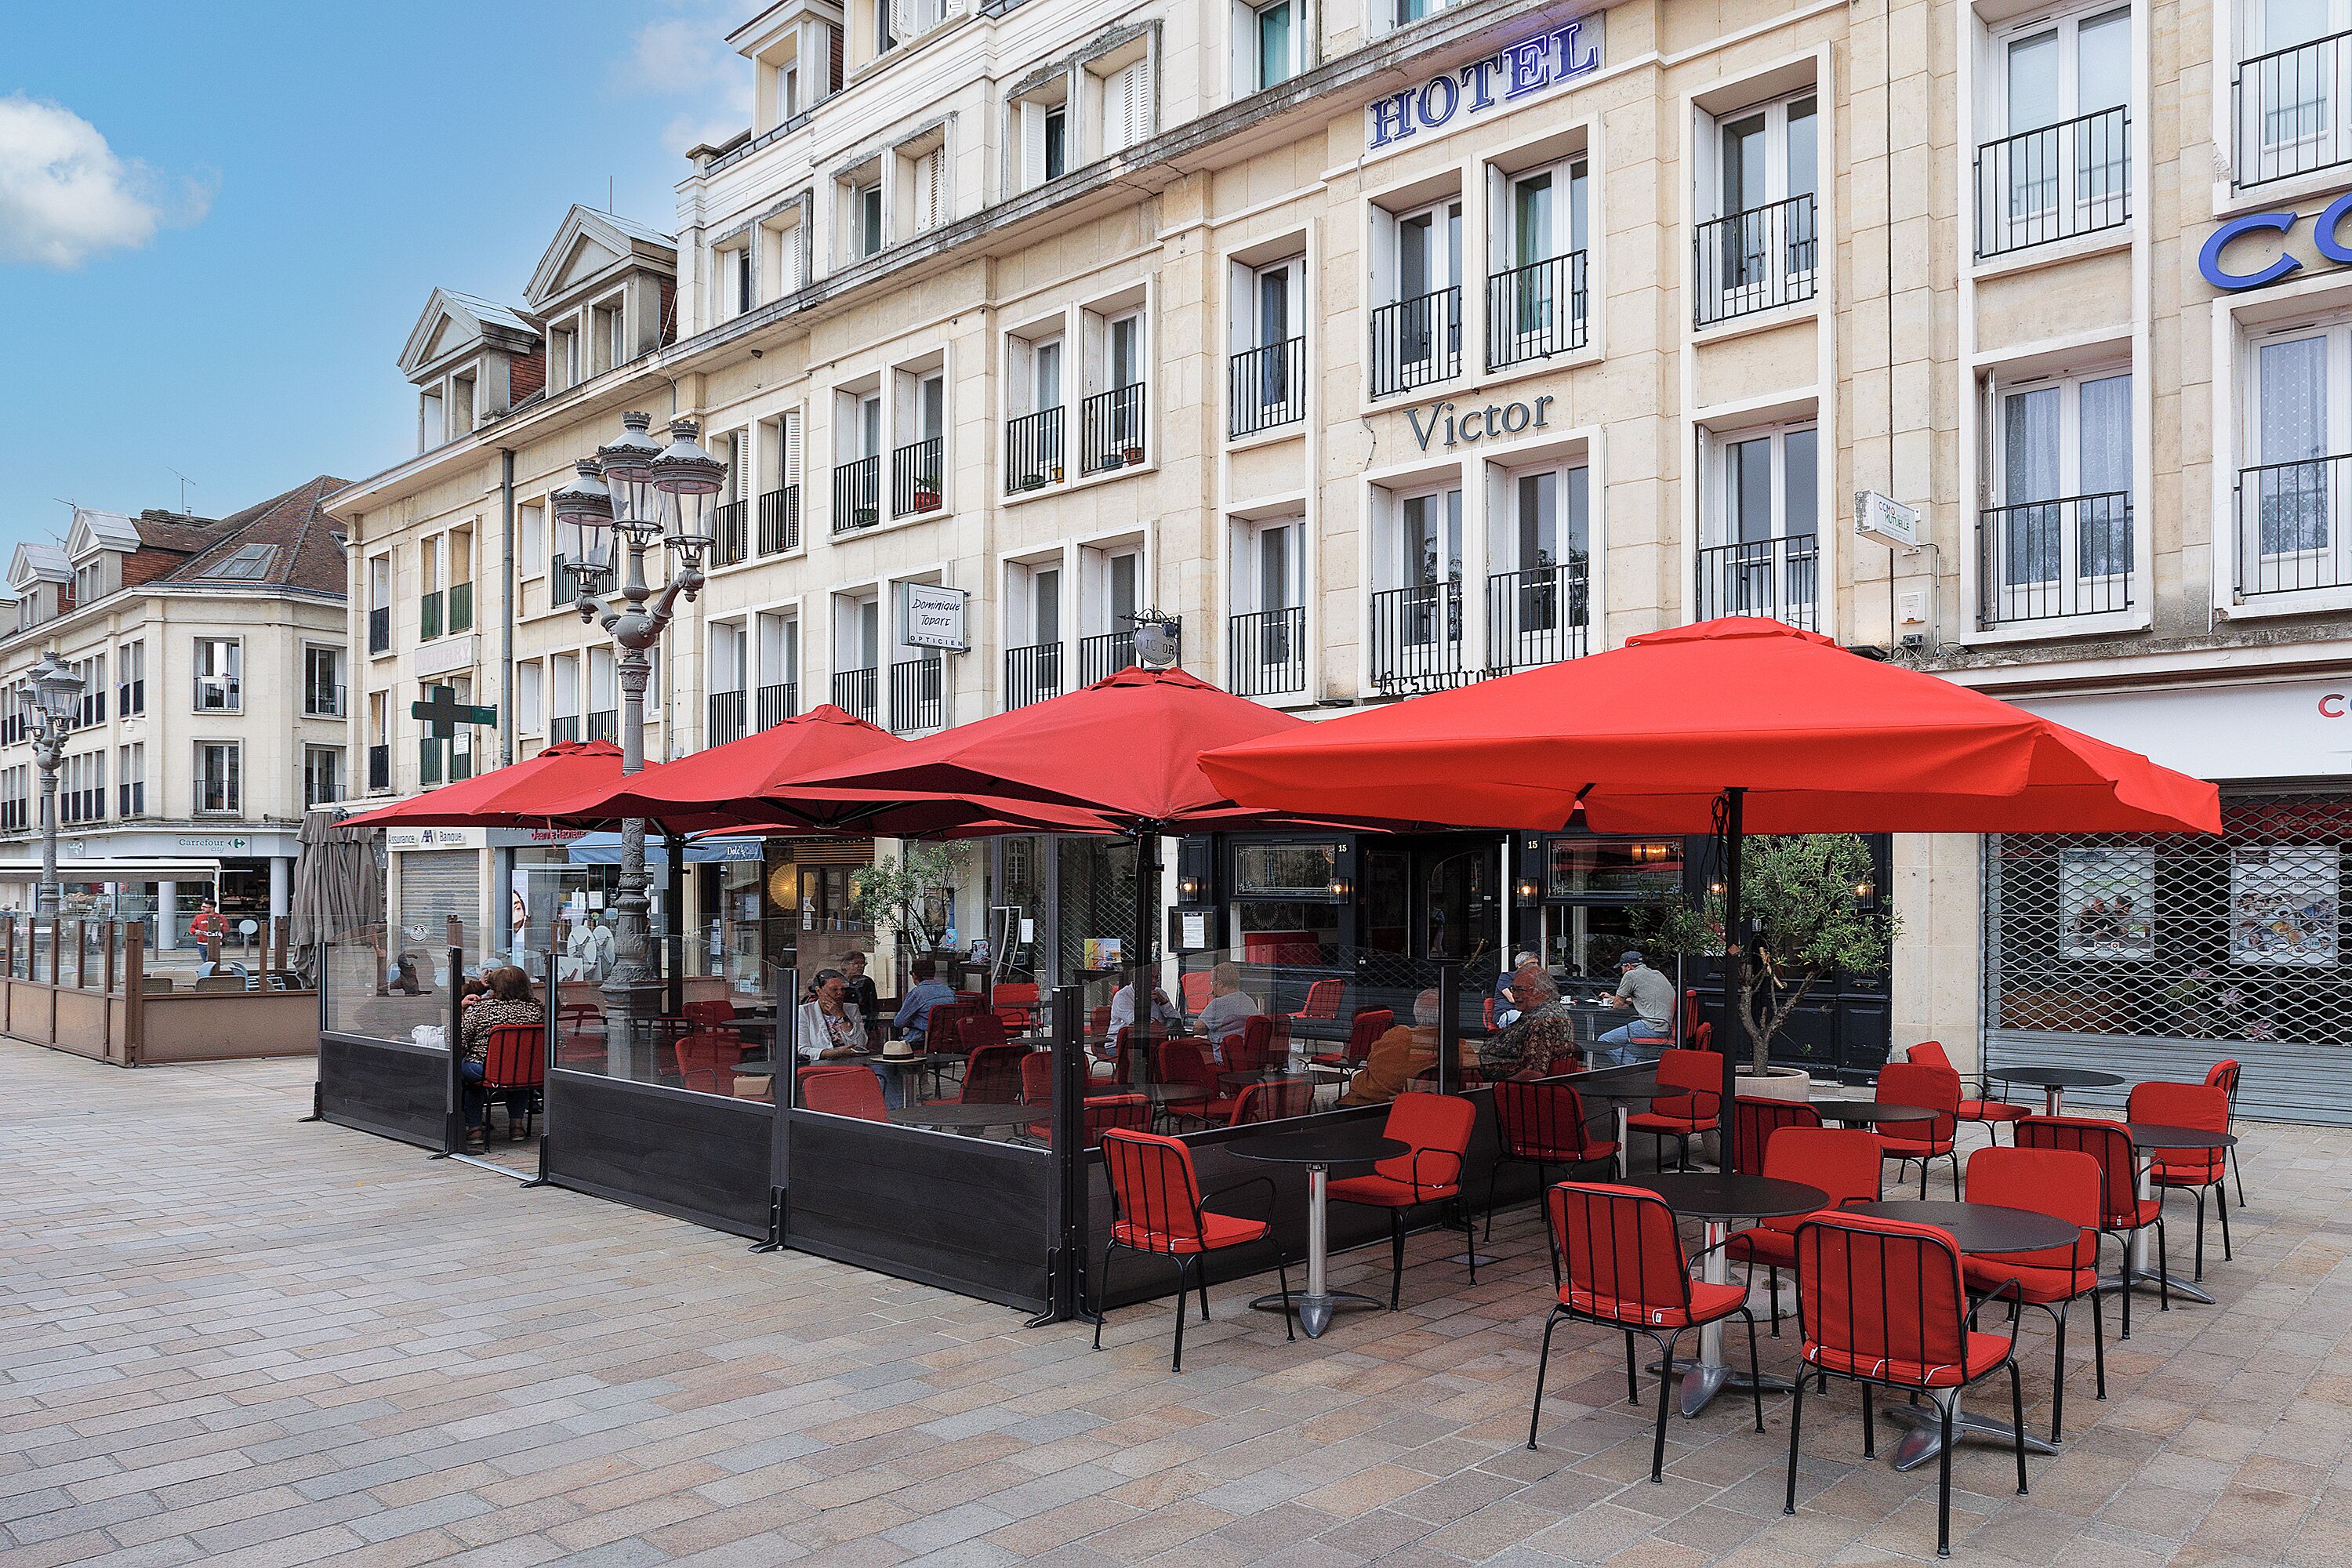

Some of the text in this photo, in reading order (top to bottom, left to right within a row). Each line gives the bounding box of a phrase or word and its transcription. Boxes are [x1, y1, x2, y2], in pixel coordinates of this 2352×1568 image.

[1368, 23, 1599, 150] HOTEL
[1403, 394, 1554, 452] Victor
[1878, 501, 1896, 516] CCMO
[911, 598, 961, 612] Dominique
[909, 635, 963, 647] OPTICIEN
[388, 829, 462, 844] Assurance AXA Banque
[1527, 840, 1538, 849] 15
